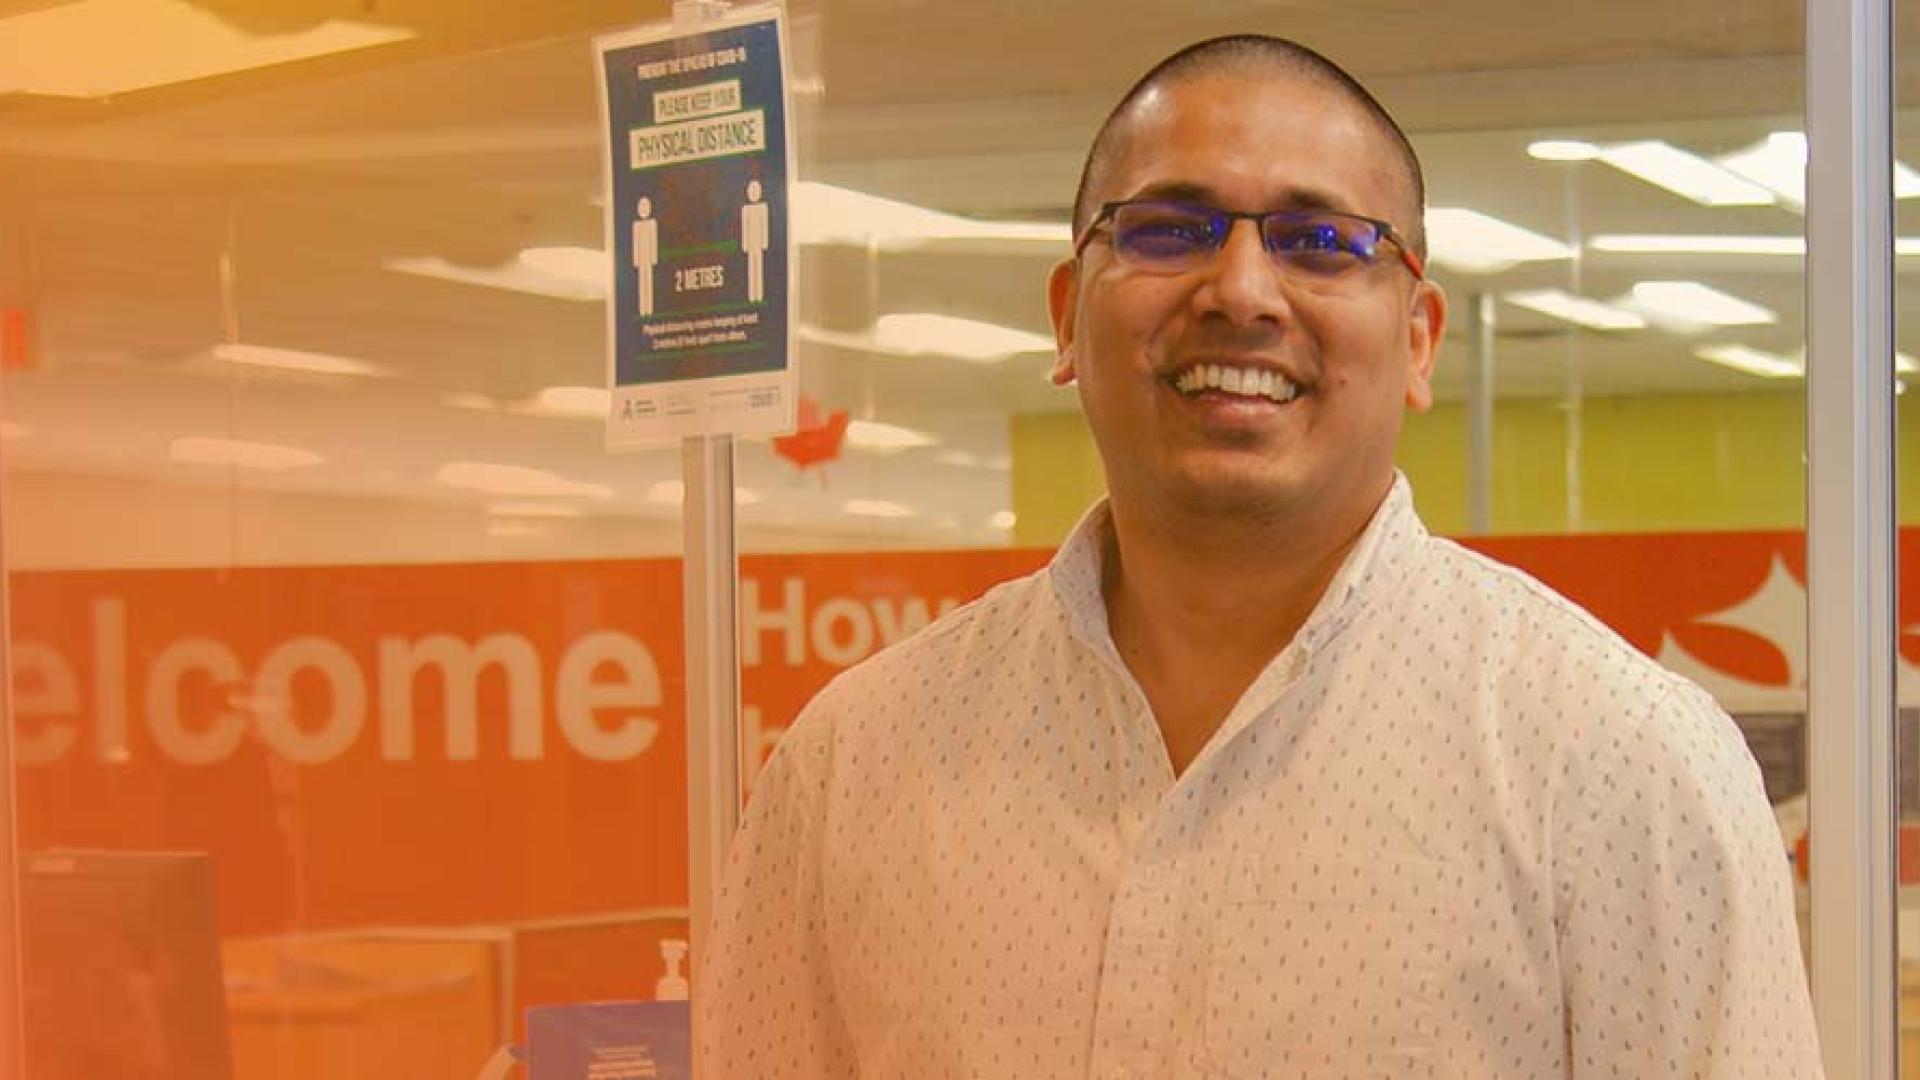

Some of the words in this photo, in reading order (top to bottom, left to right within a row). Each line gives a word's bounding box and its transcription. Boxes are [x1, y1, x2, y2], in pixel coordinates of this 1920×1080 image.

[639, 127, 695, 161] PHYSICAL
[697, 117, 757, 153] DISTANCE
[675, 270, 682, 293] 2
